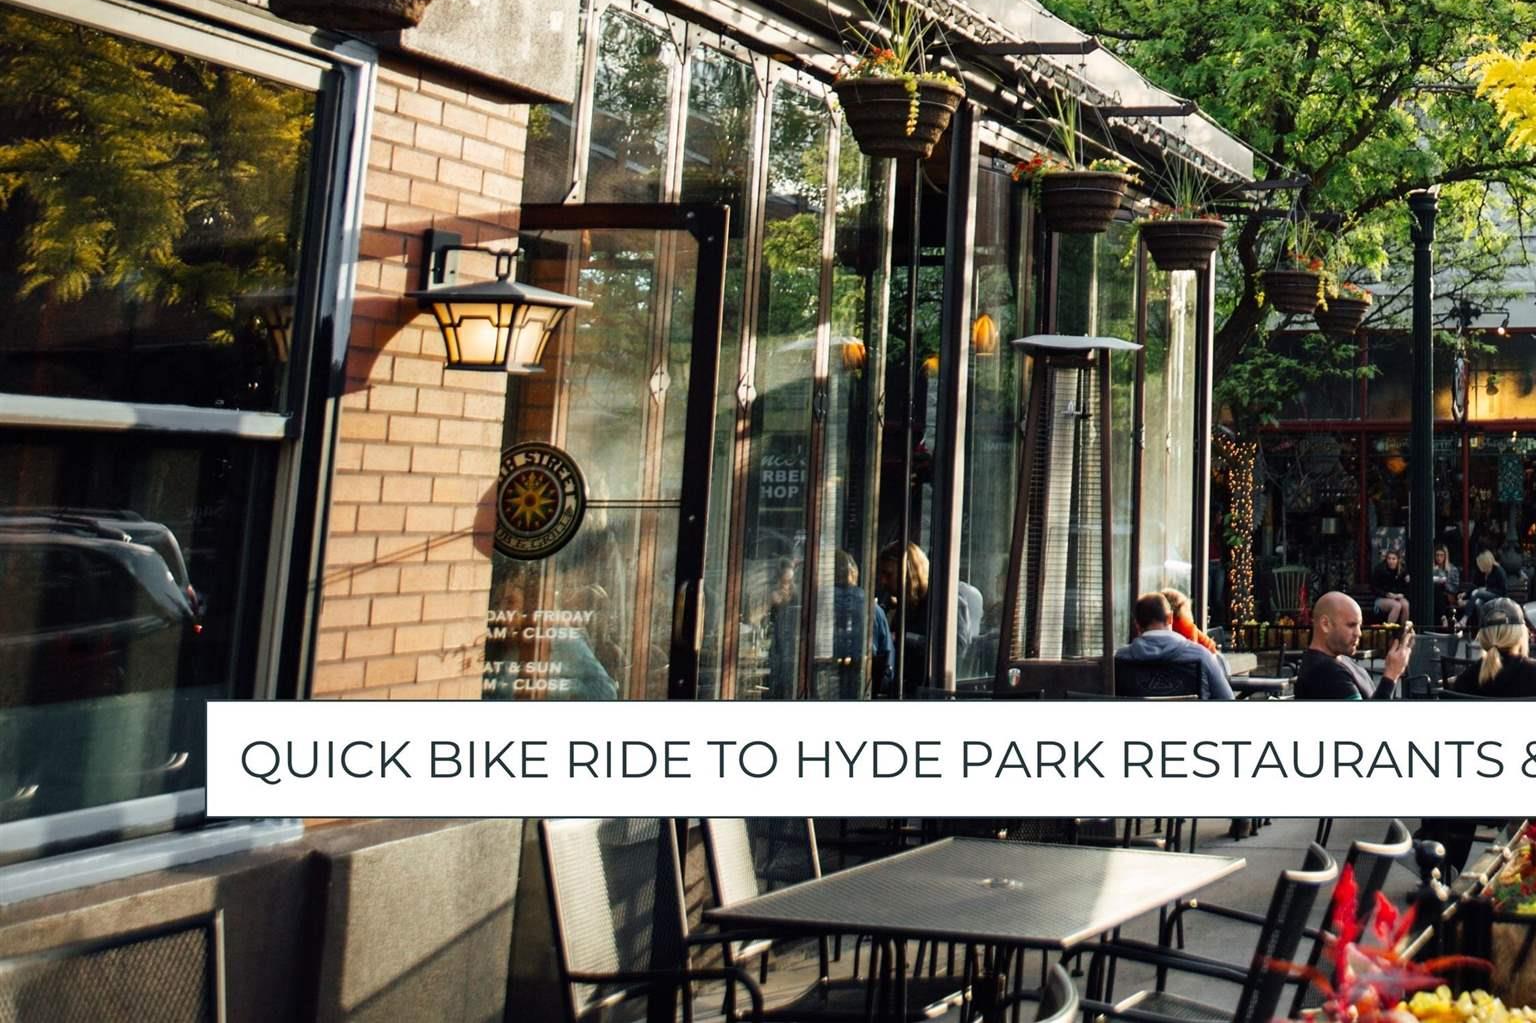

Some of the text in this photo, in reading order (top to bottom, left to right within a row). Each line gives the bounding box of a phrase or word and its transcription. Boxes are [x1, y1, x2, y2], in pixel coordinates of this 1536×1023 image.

[525, 452, 576, 496] STREET
[762, 470, 806, 483] RBE
[760, 486, 800, 498] HOP
[487, 610, 517, 622] DAY
[533, 610, 595, 622] FRIDAY
[523, 627, 579, 639] CLOSE
[483, 661, 563, 673] AT & SUN
[513, 678, 571, 690] CLOSE
